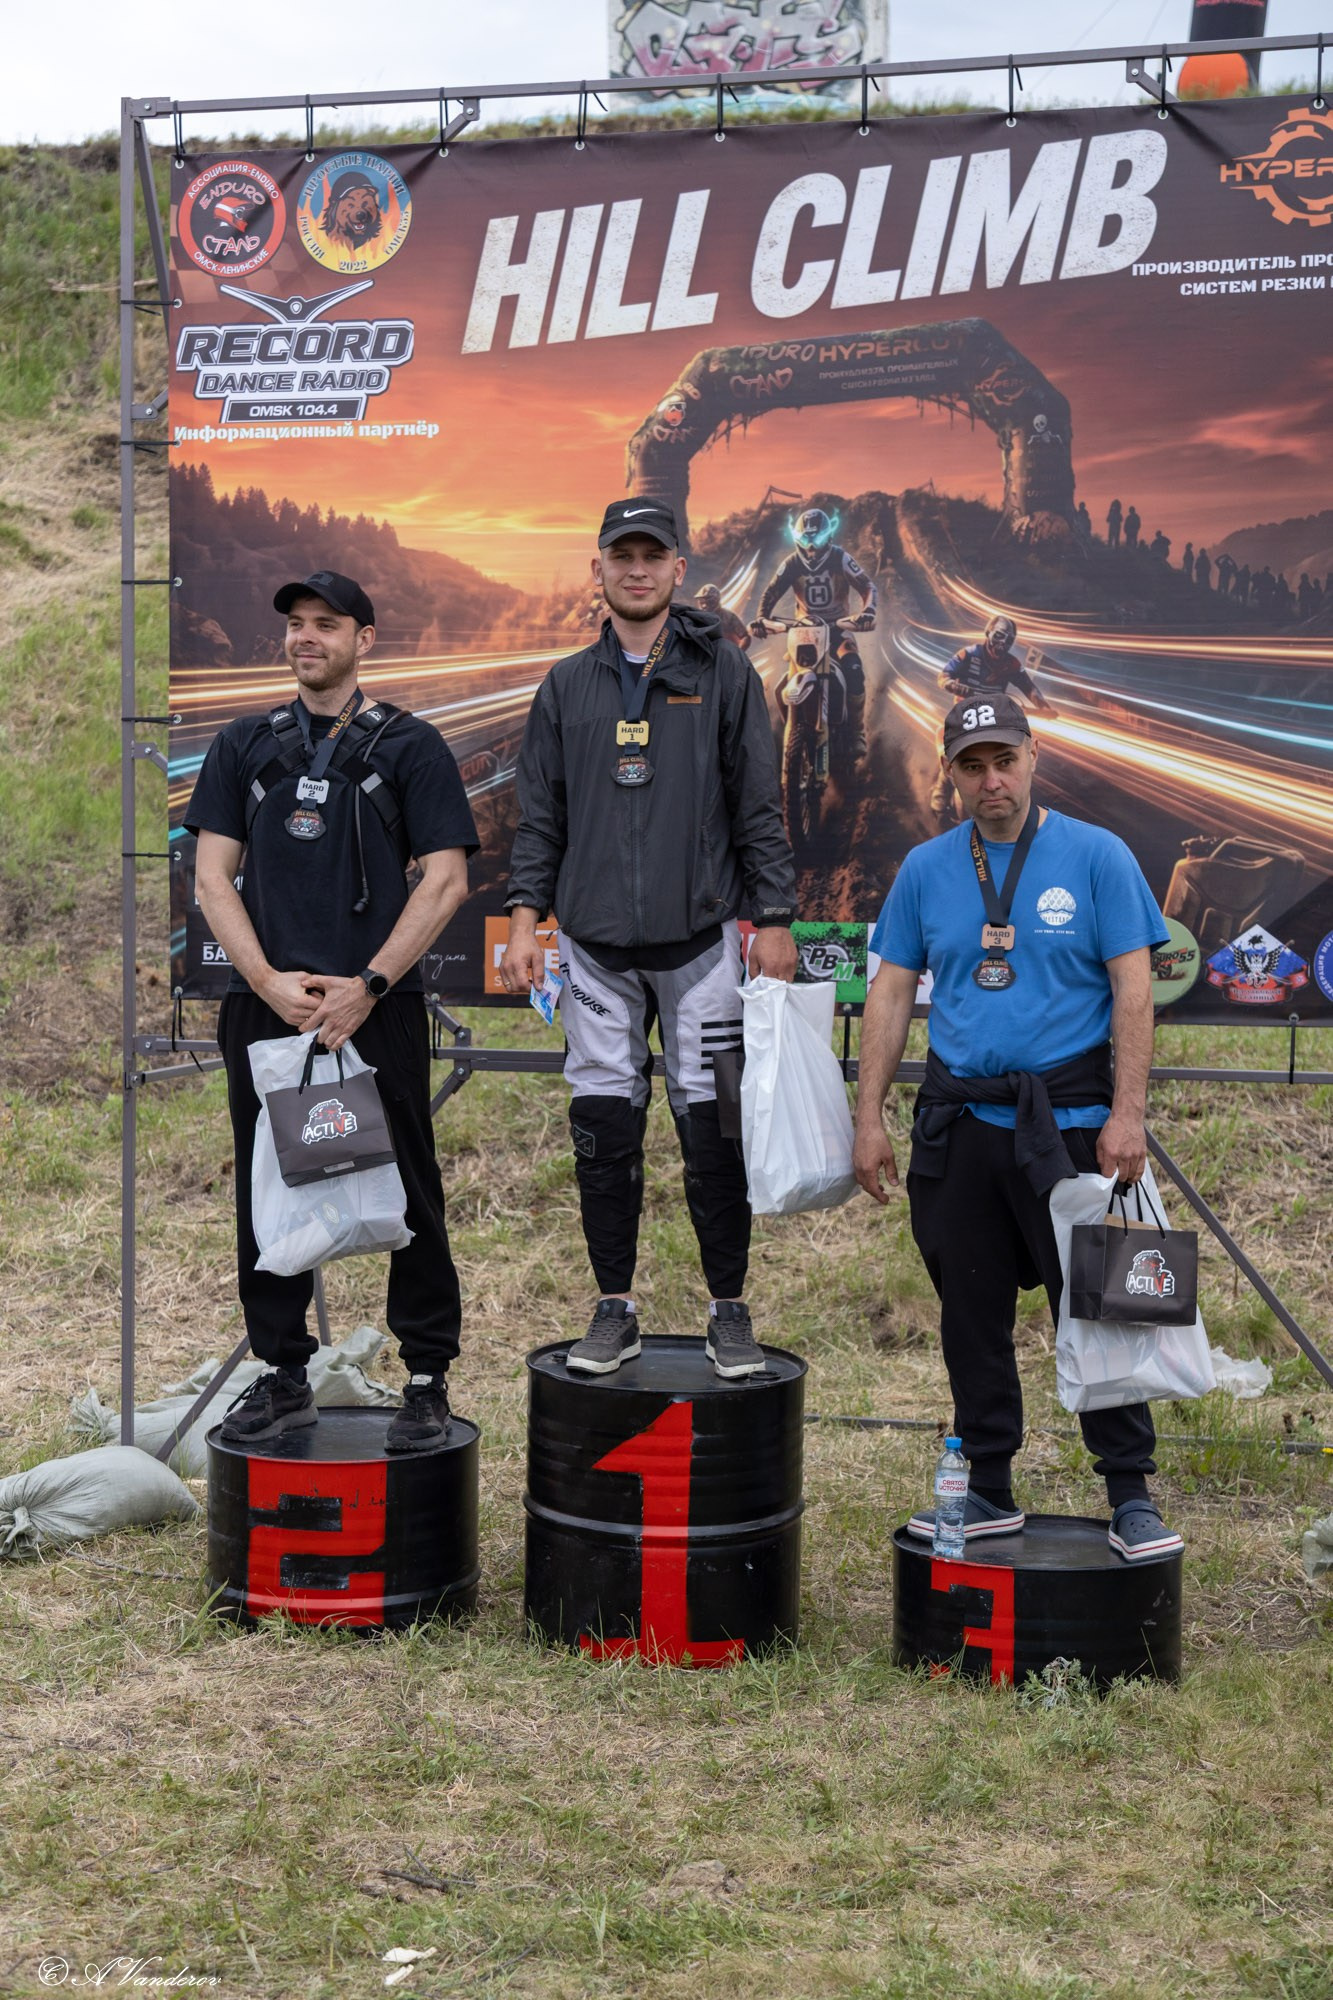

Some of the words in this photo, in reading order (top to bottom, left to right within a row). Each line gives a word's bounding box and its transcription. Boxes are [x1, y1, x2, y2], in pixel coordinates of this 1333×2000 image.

[303, 154, 363, 199] ПРОСТЫЕ
[364, 154, 408, 197] ПАРНИ
[199, 181, 266, 210] ENDURO
[298, 215, 327, 260] РОССИЯ
[461, 188, 720, 355] HILL
[751, 129, 1168, 319] CLIMB
[338, 259, 369, 272] 2022
[1131, 255, 1297, 277] ПРОИЗВОДИТЕЛЬ
[1179, 279, 1257, 296] СИСТЕМ
[1261, 275, 1326, 292] РЕЗКИ
[178, 324, 413, 366] RECORD
[201, 371, 297, 393] DANCE
[299, 369, 387, 392] RADIO
[249, 405, 292, 417] OMSK
[297, 403, 338, 416] 104.4
[174, 422, 354, 444] Информационный
[358, 421, 440, 438] партнёр
[962, 705, 997, 731] 32
[629, 733, 635, 741] 1
[302, 782, 325, 792] HARD
[307, 790, 316, 798] 2
[986, 930, 1011, 939] HARD
[304, 1114, 354, 1140] ACTIVE
[1128, 1272, 1172, 1293] ACTIVE
[247, 1456, 388, 1627] 2
[580, 1400, 745, 1669] 1
[931, 1555, 1015, 1690] 3
